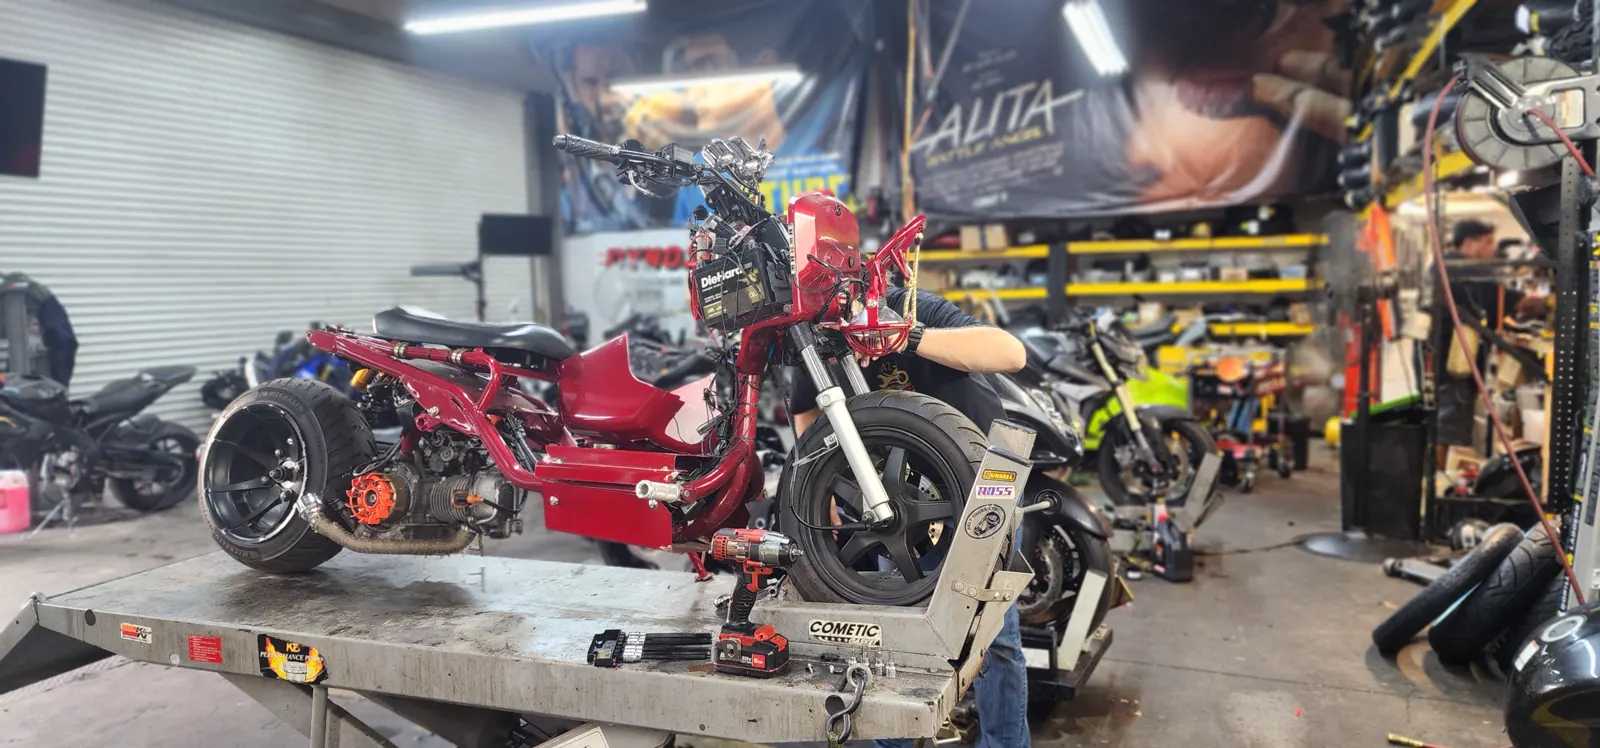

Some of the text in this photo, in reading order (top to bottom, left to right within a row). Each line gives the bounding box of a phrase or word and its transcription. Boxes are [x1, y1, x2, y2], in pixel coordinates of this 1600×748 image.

[909, 78, 1083, 154] ALITA
[984, 471, 1014, 480] RUSSELL
[977, 486, 1013, 496] ROSS
[1560, 504, 1581, 611] GORILL LADDERS
[810, 621, 880, 637] COMETIC
[260, 651, 304, 661] PERFORMANCE
